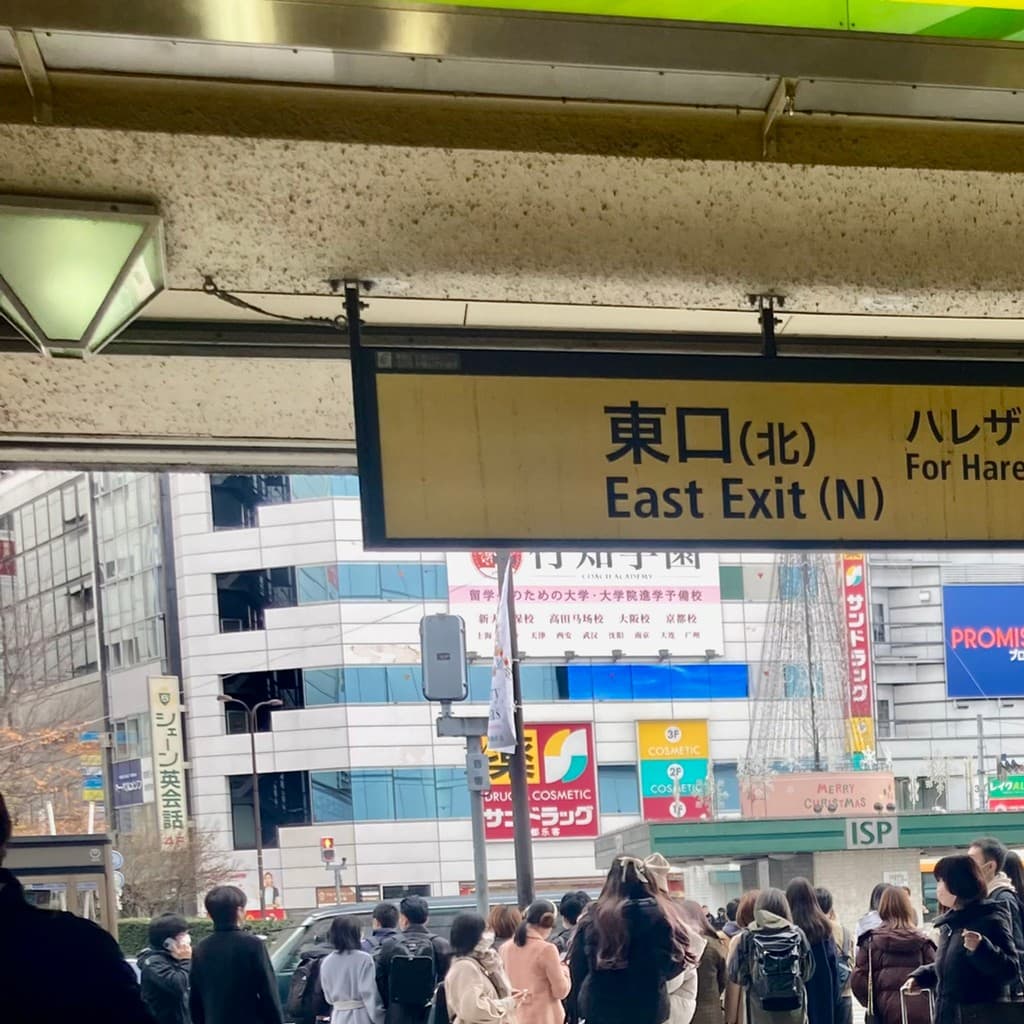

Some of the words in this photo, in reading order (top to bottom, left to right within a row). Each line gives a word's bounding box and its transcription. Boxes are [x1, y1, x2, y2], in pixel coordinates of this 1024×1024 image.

[603, 401, 816, 467] 東口(北)
[906, 454, 951, 481] For
[606, 477, 704, 519] East
[722, 477, 806, 519] Exit
[819, 476, 885, 521] (N)
[469, 589, 703, 602] 留学のための大学・大学院進学予備校
[847, 594, 869, 702] サンドラッグ
[667, 729, 680, 739] 3F
[648, 746, 702, 756] COSMETIC
[155, 713, 184, 829] シェーン英会話
[669, 768, 683, 777] 2F
[650, 783, 703, 794] COSETIC
[817, 783, 855, 794] MERRY
[532, 789, 592, 801] COSMETIC
[804, 797, 867, 809] CHRISTMAS
[851, 821, 892, 845] ISP
[163, 836, 184, 847] 4F
